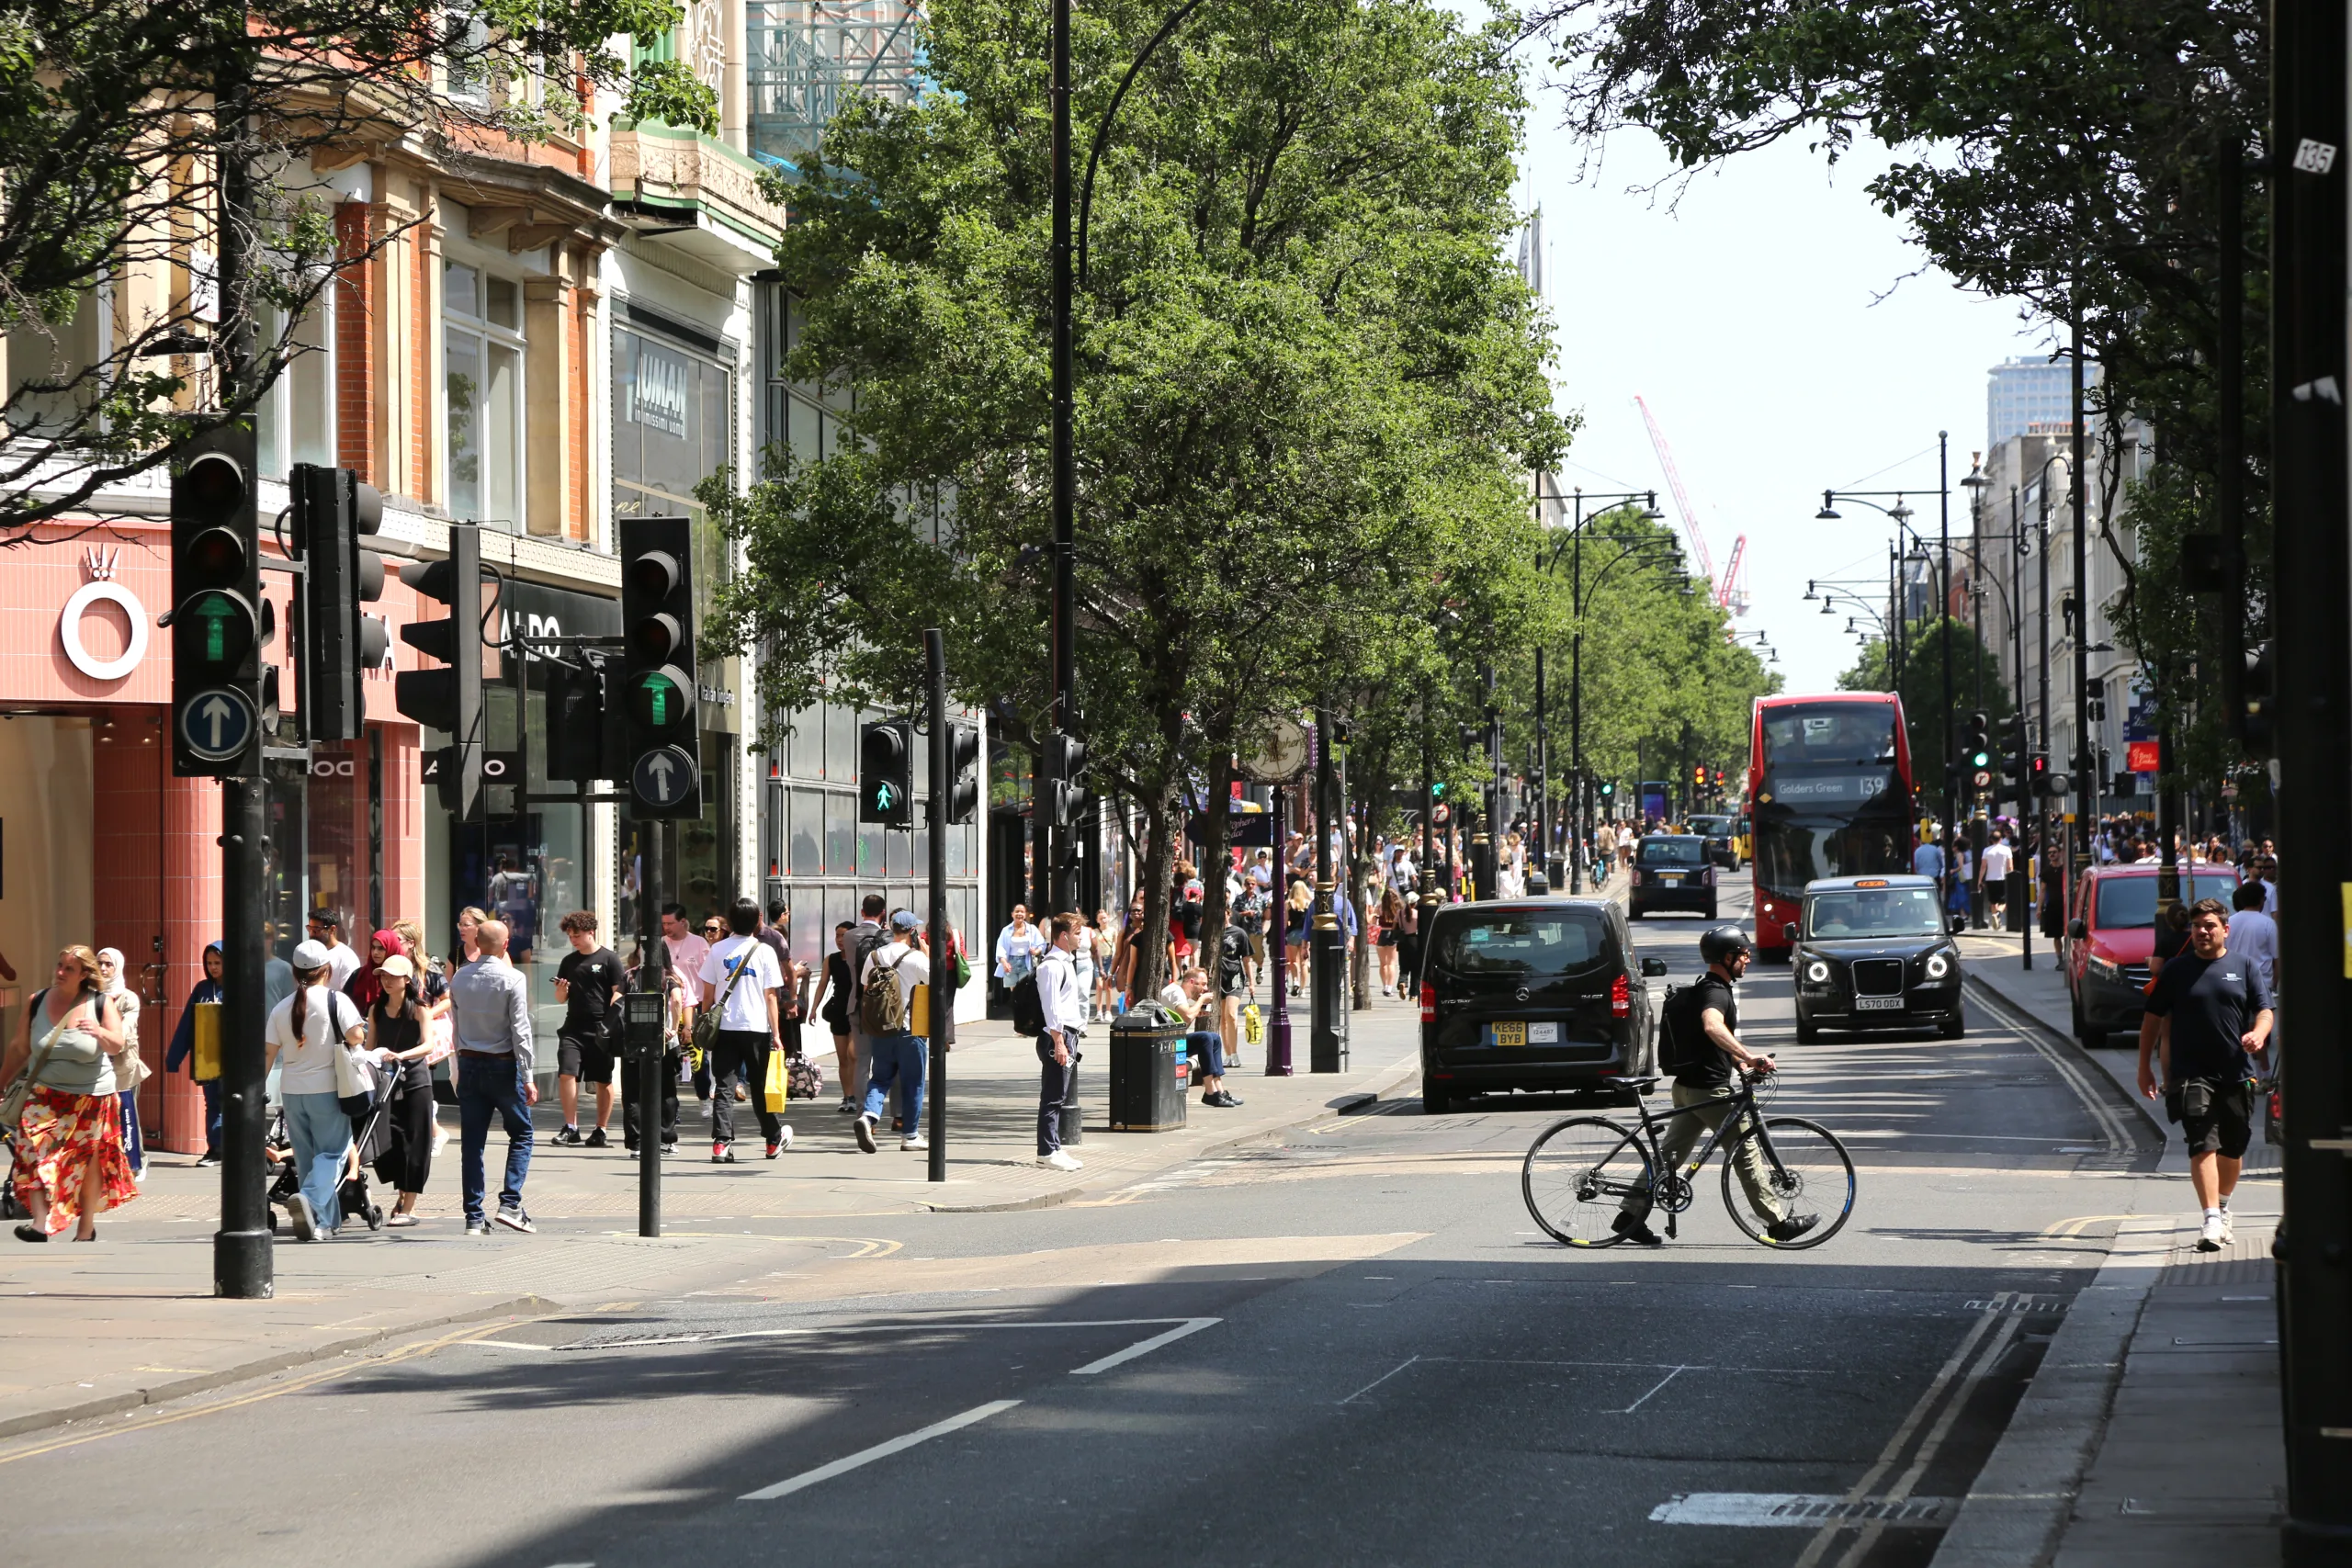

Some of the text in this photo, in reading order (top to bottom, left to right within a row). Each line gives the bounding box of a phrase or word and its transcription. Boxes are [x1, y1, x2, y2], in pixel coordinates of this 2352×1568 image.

[2301, 143, 2331, 172] 135
[424, 759, 505, 776] AO
[1779, 777, 1884, 795] Golders Green 139
[1860, 998, 1901, 1009] LS70 ODX
[1495, 1022, 1523, 1033] KE66
[1499, 1033, 1521, 1044] BYB
